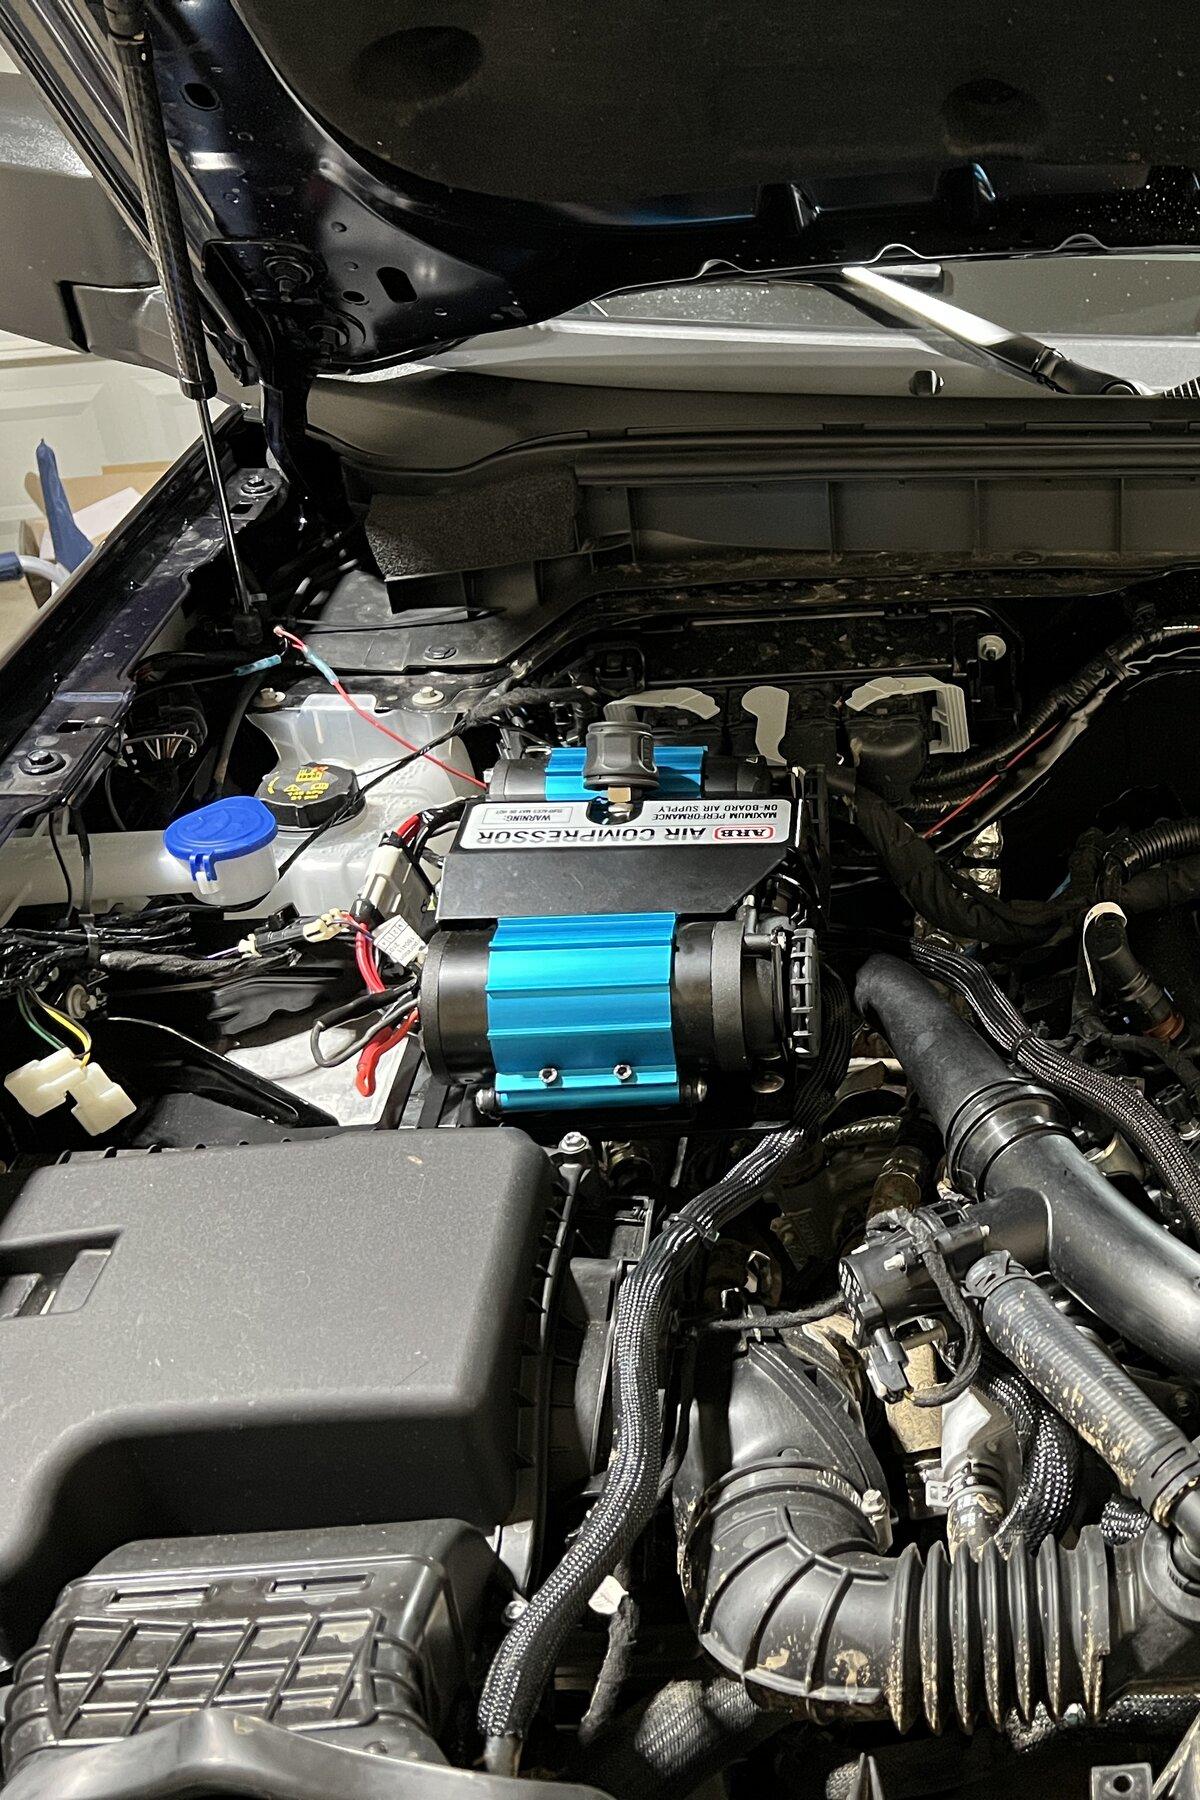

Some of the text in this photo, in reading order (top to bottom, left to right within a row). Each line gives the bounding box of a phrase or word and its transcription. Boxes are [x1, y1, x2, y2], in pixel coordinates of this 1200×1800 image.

[657, 805, 699, 813] SUPPLY
[724, 804, 778, 812] ON-BOARD
[503, 814, 551, 822] WARNING:
[651, 811, 777, 821] MAXIMUM PERFORMANCE
[477, 828, 767, 844] ARB AIR COMPRESSOR
